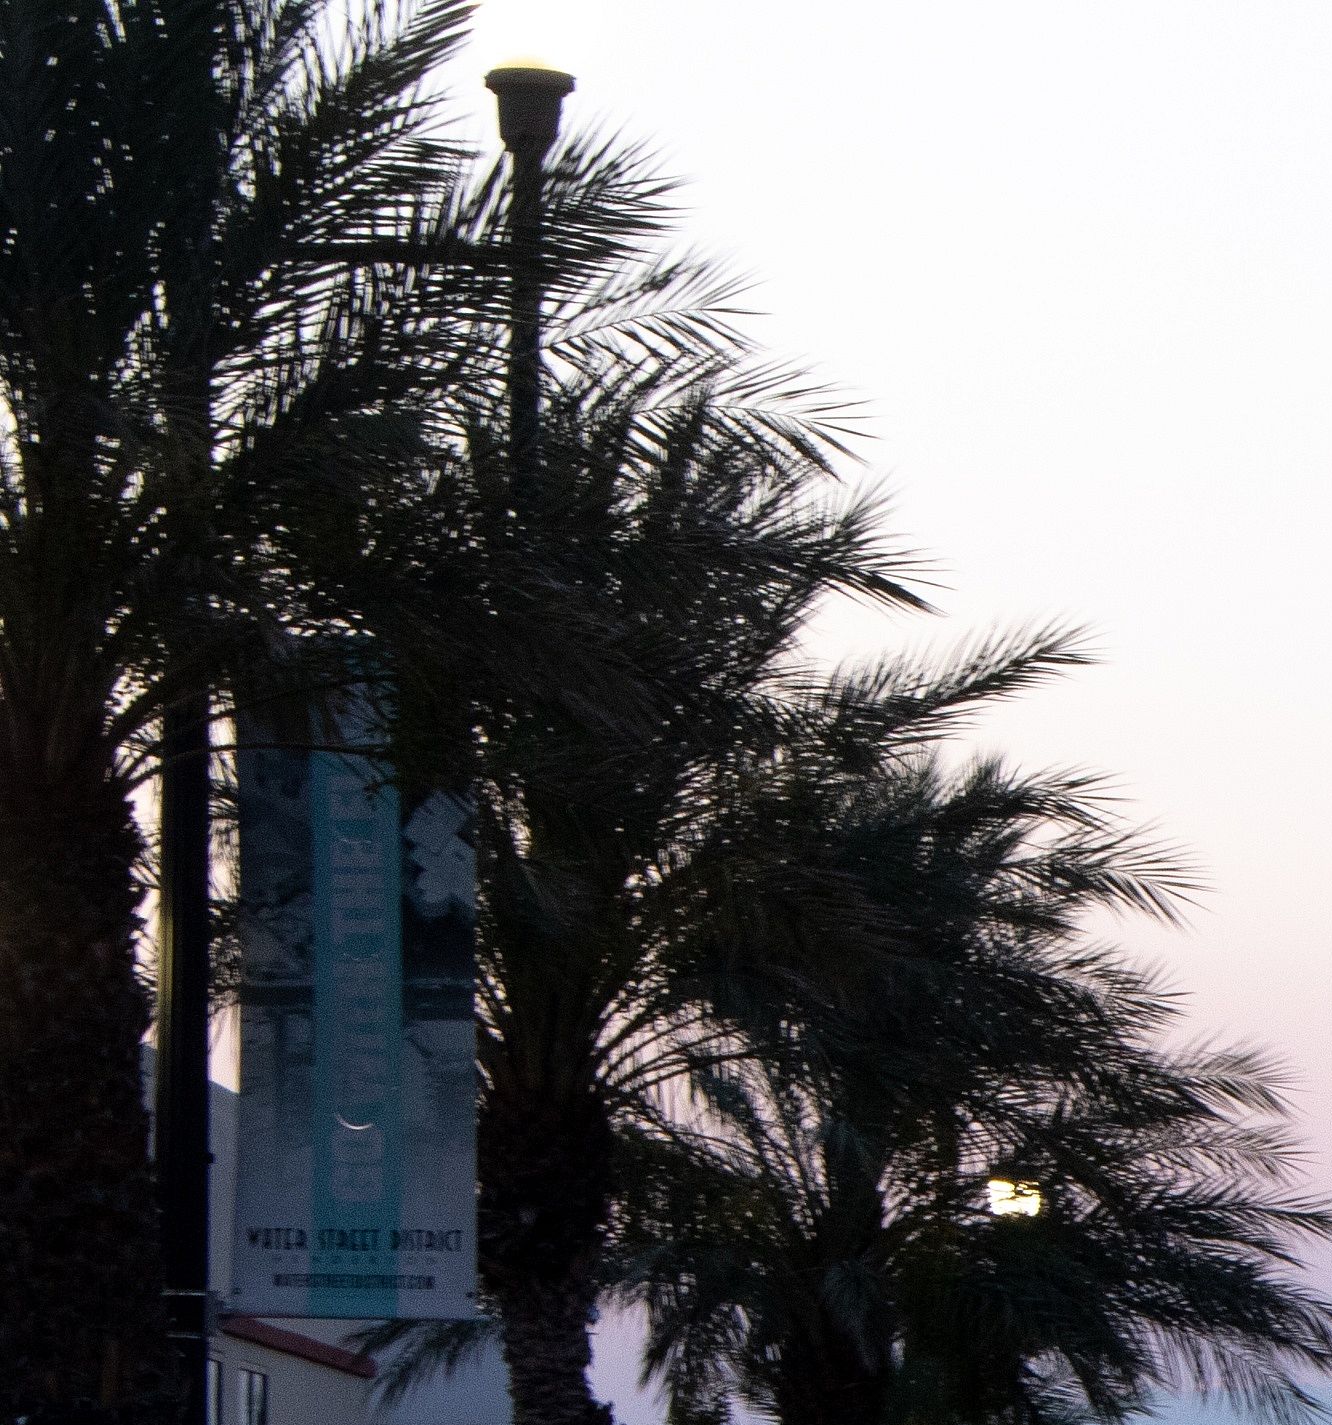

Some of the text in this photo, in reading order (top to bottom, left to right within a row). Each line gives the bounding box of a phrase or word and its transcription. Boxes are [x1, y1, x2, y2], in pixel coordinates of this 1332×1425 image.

[247, 1227, 462, 1252] WATER STREET DISTRICT
